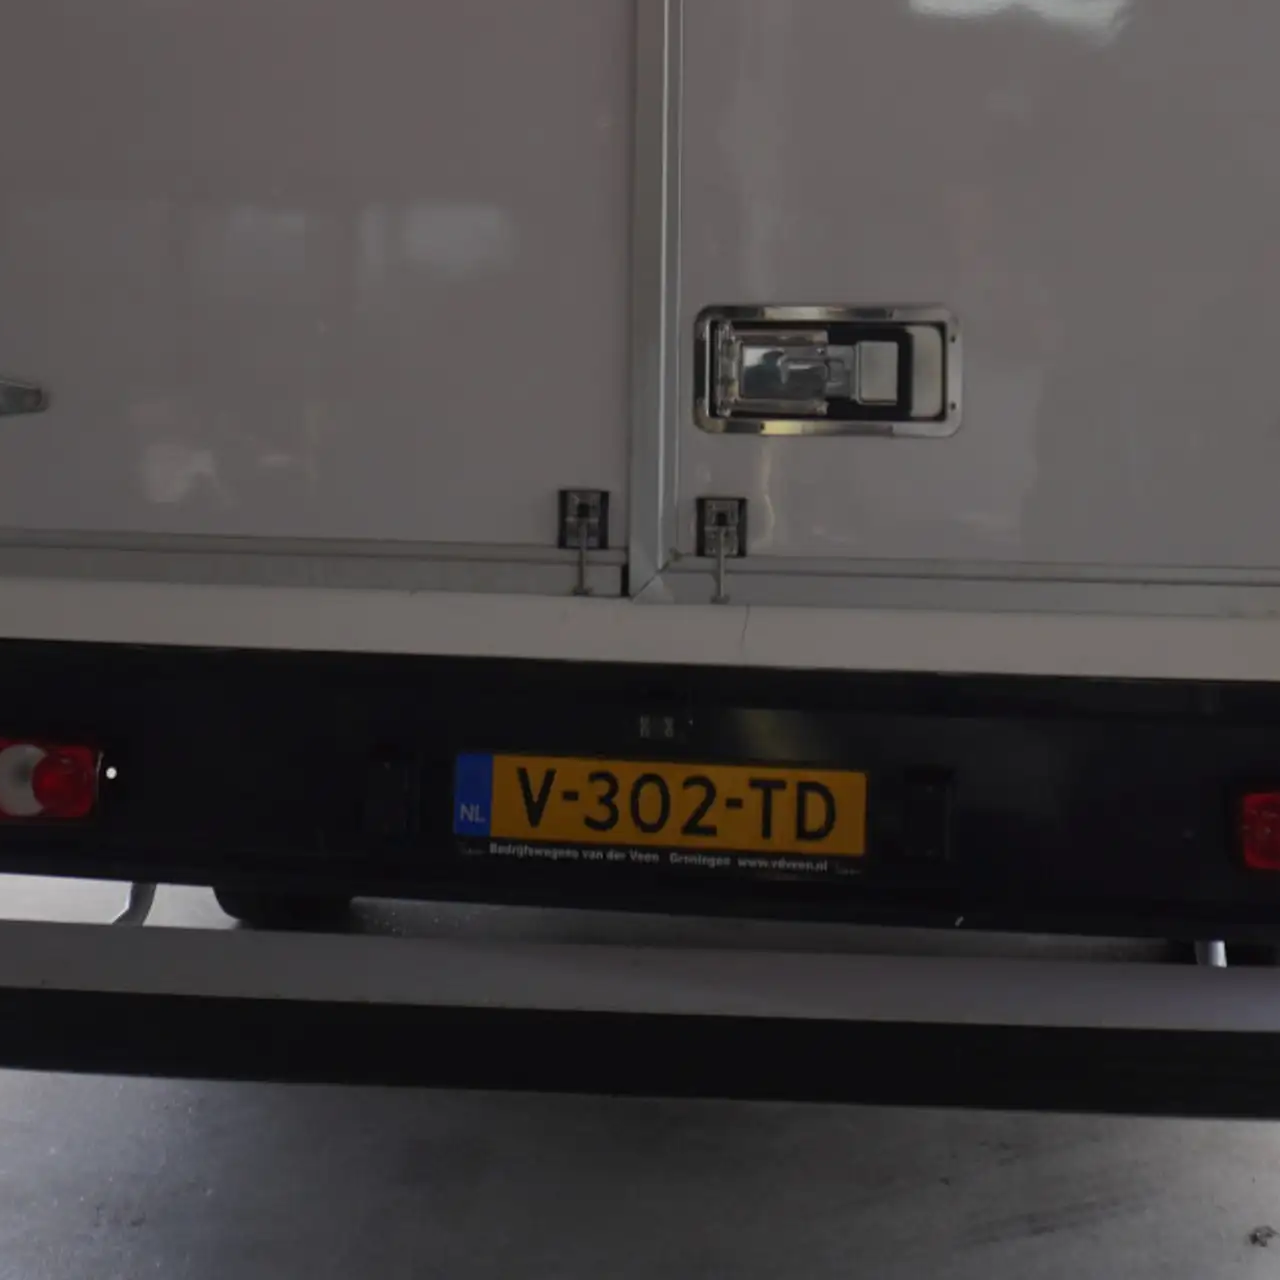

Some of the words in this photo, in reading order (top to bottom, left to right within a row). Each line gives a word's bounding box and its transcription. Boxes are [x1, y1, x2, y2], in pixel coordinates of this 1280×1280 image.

[459, 803, 487, 824] NL
[517, 767, 837, 840] V-302-TD
[582, 849, 604, 860] van
[606, 848, 627, 861] der
[630, 850, 660, 862] Veen
